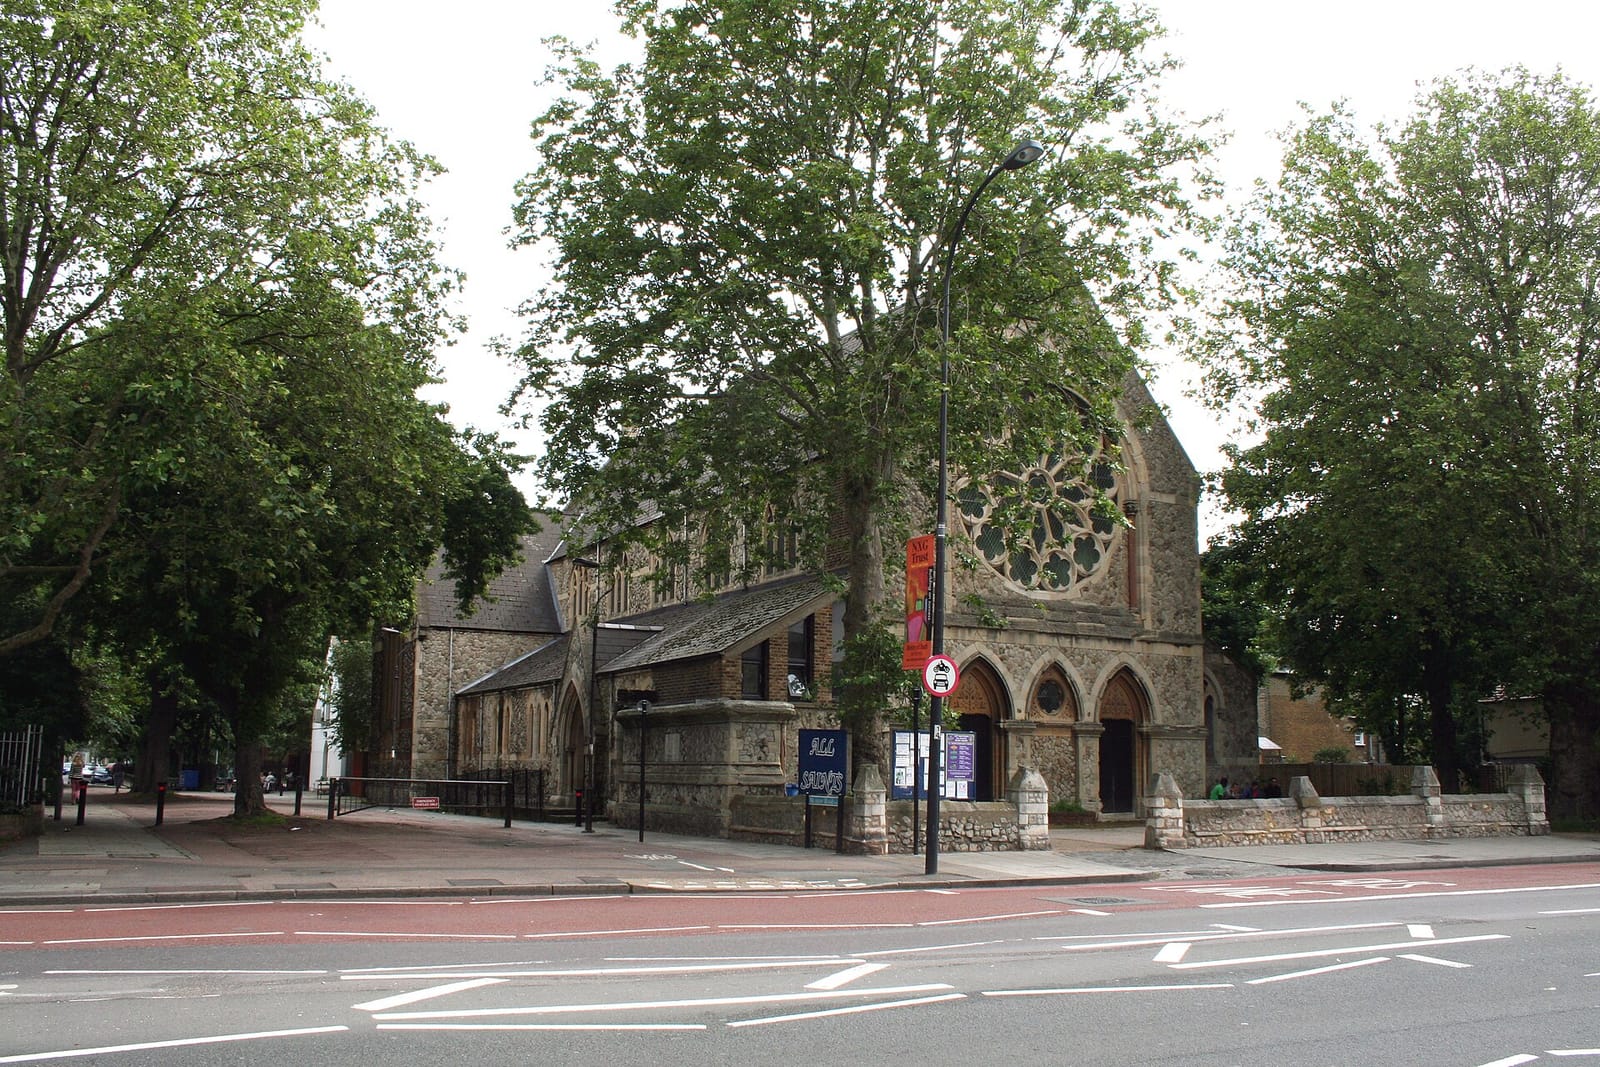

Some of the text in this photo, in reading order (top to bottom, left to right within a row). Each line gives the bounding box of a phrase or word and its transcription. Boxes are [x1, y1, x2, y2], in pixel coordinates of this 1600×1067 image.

[912, 540, 928, 552] NXG
[912, 552, 929, 563] Trust
[810, 737, 835, 757] ALL
[800, 770, 844, 795] SAINTS
